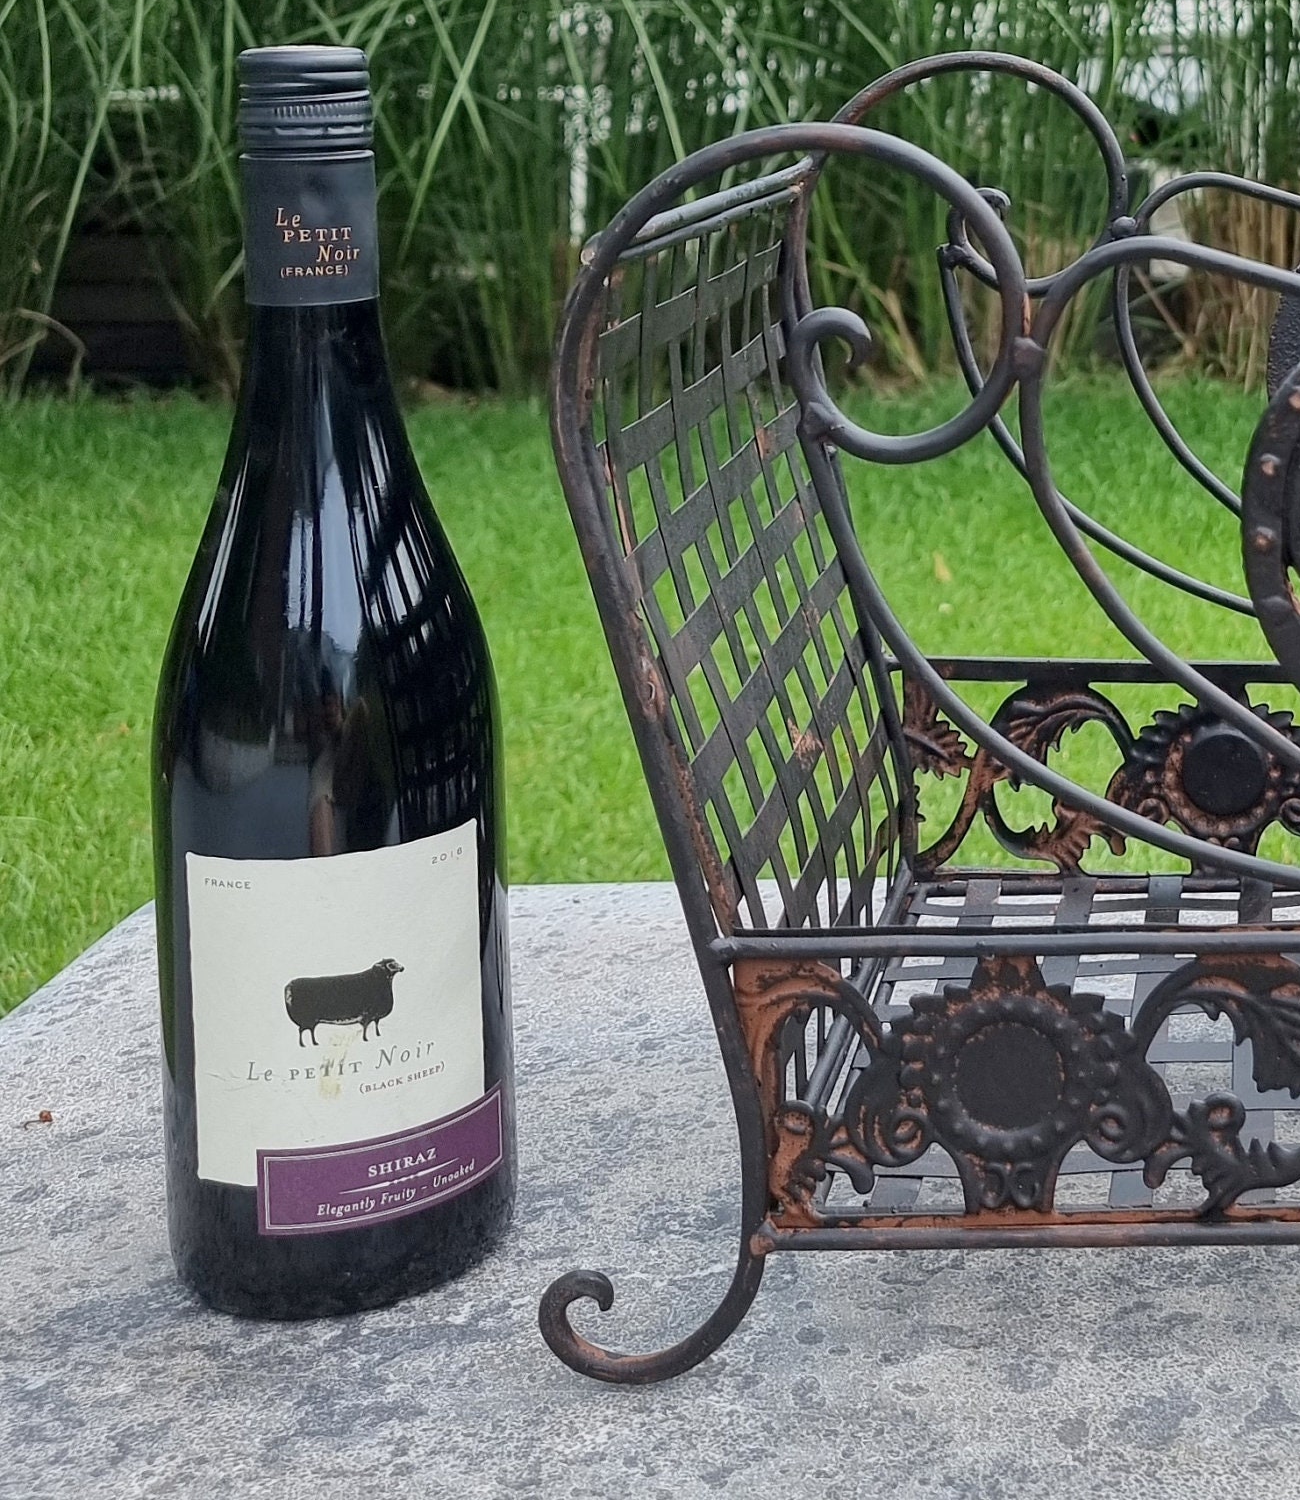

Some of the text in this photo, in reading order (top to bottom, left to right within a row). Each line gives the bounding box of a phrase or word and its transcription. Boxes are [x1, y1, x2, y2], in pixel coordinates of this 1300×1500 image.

[276, 207, 301, 228] Le
[283, 227, 352, 243] PETIT
[316, 244, 360, 263] Noir
[280, 264, 349, 278] (FRANCE)
[204, 877, 251, 890] FRANCE
[246, 1040, 435, 1082] Le PETIT Noir
[358, 1061, 446, 1095] (BLACK SHEEP)
[368, 1147, 437, 1178] SHIRAZ
[316, 1197, 376, 1218] Elegantly
[380, 1187, 417, 1202] Fruity
[433, 1158, 475, 1188] Unoaked
